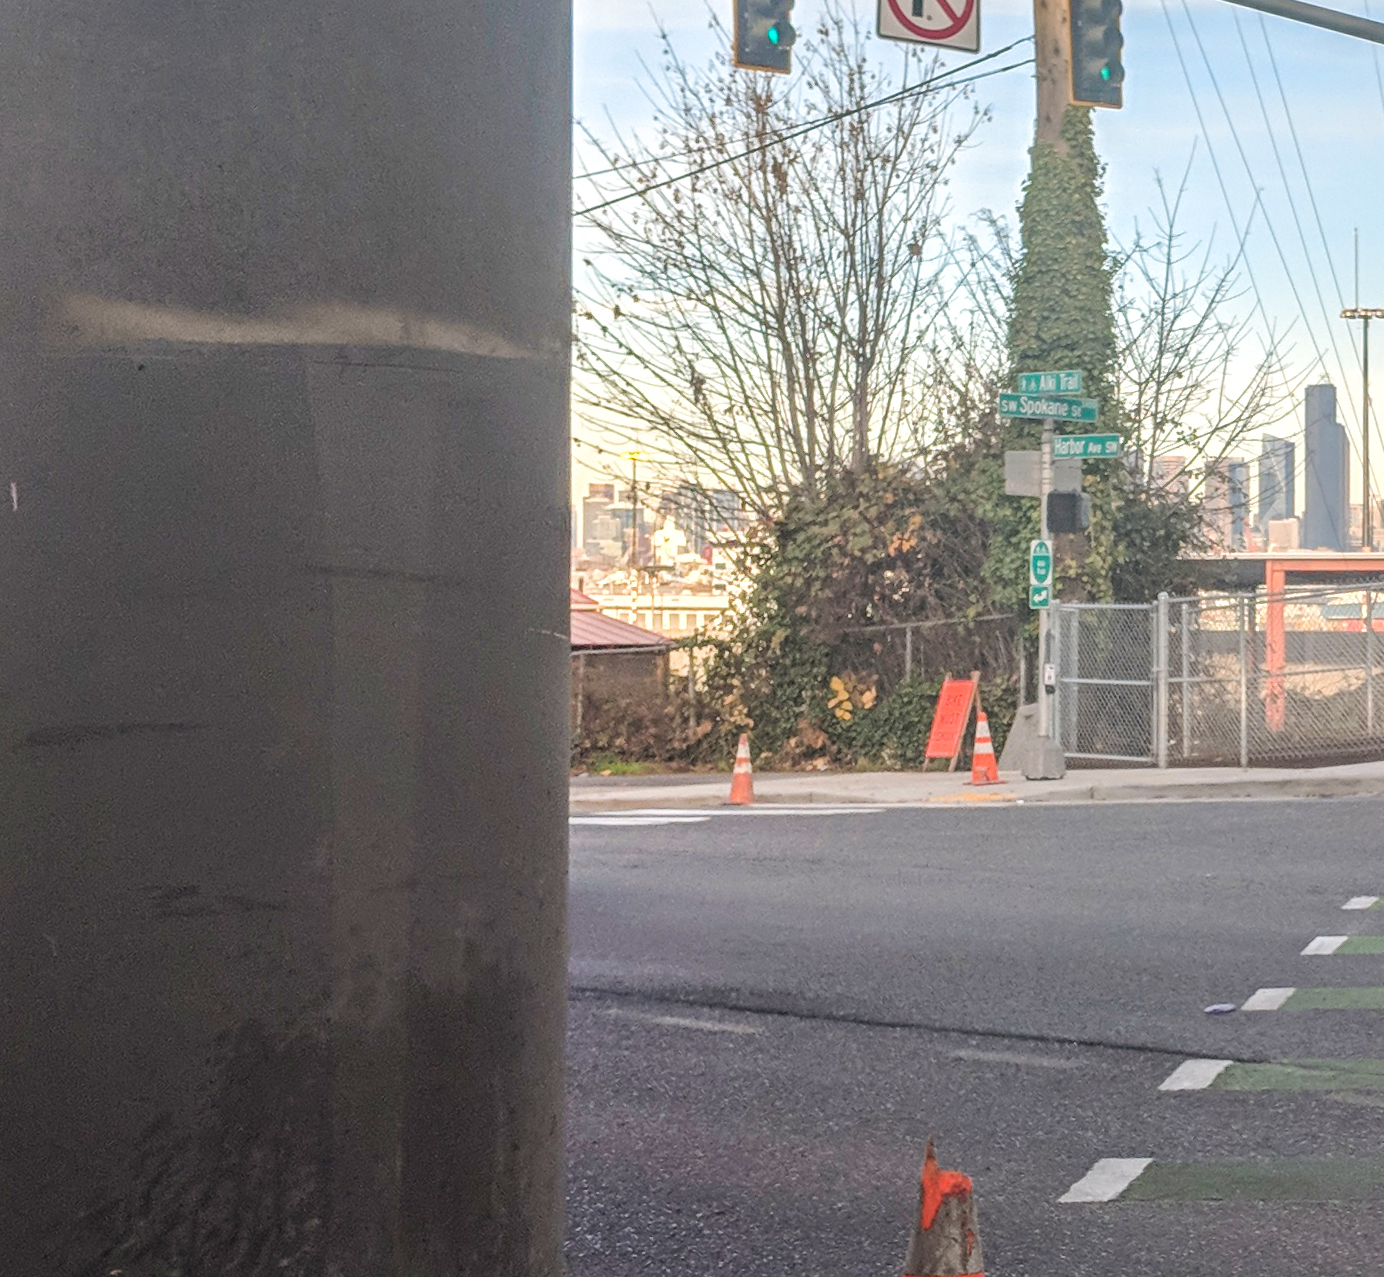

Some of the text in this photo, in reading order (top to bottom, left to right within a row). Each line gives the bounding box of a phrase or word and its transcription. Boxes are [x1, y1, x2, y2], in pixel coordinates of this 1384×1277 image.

[1039, 372, 1080, 392] Alki Trail
[1001, 399, 1018, 412] SW
[1020, 396, 1069, 417] Spokane
[1054, 437, 1085, 455] Harbor
[1087, 441, 1102, 454] Ave
